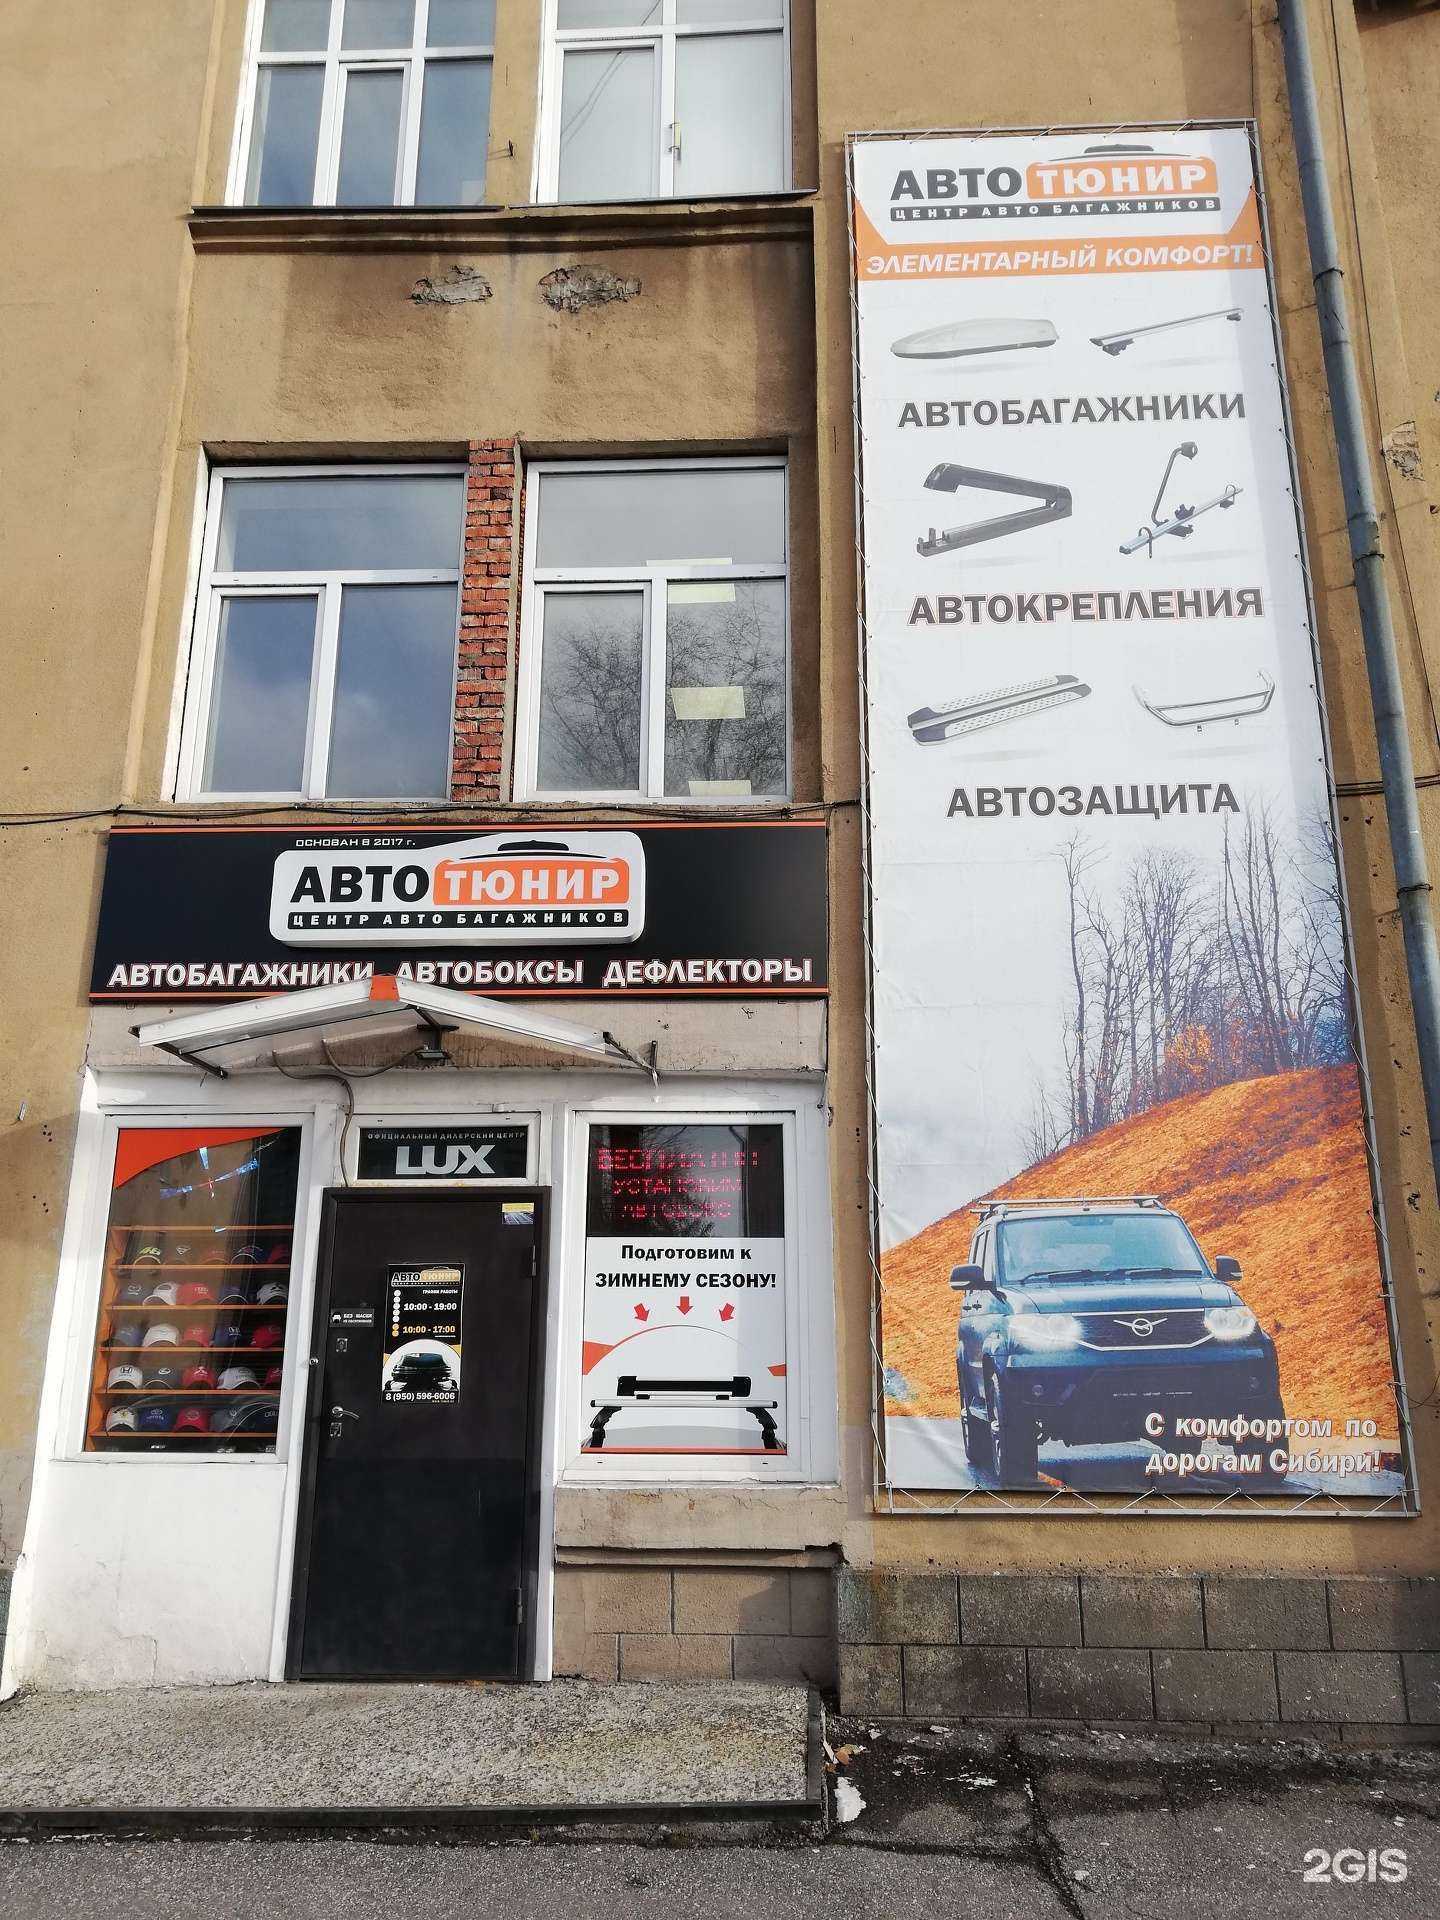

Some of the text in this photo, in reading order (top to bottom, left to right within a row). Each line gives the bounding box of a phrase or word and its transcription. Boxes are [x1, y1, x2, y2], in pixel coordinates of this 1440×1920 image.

[895, 199, 1216, 220] ЦЕНТР АВТО БАГАЖНИКОВ
[865, 243, 1254, 275] ЭЛЕМЕНТАРНЫЙ КОМФОРТ!
[898, 393, 1246, 428] АВТОБАГАЖНИКИ
[908, 588, 1264, 625] АВТОКРЕПЛЕНИЯ
[946, 784, 1241, 820] АВТОЗАЩИТА
[296, 838, 359, 848] ОСНОВАН
[373, 838, 403, 848] 2017
[293, 911, 624, 928] ЦЕНТР АВТО БАГАЖНИКОВ
[107, 958, 814, 988] АВТОБАГАЖНИКИ АВТОБОКСЫ ДЕФЛЕКТОРЫ
[367, 1131, 526, 1141] ОФИЦИАЛЬНЫЙ ДИЛЕРСКИЙ ЦЕНТР
[396, 1145, 496, 1175] LUX
[621, 1244, 735, 1261] Подготовим
[595, 1272, 776, 1289] ЗИМНЕМУ СЕЗОНУ!
[403, 1302, 428, 1311] 10:00
[433, 1302, 457, 1311] 19:00
[402, 1325, 427, 1334] 10:00
[432, 1325, 456, 1333] 17:00
[1175, 1413, 1332, 1442] комфортом
[1345, 1418, 1377, 1437] по
[1145, 1448, 1383, 1477] дорогам Сибири!
